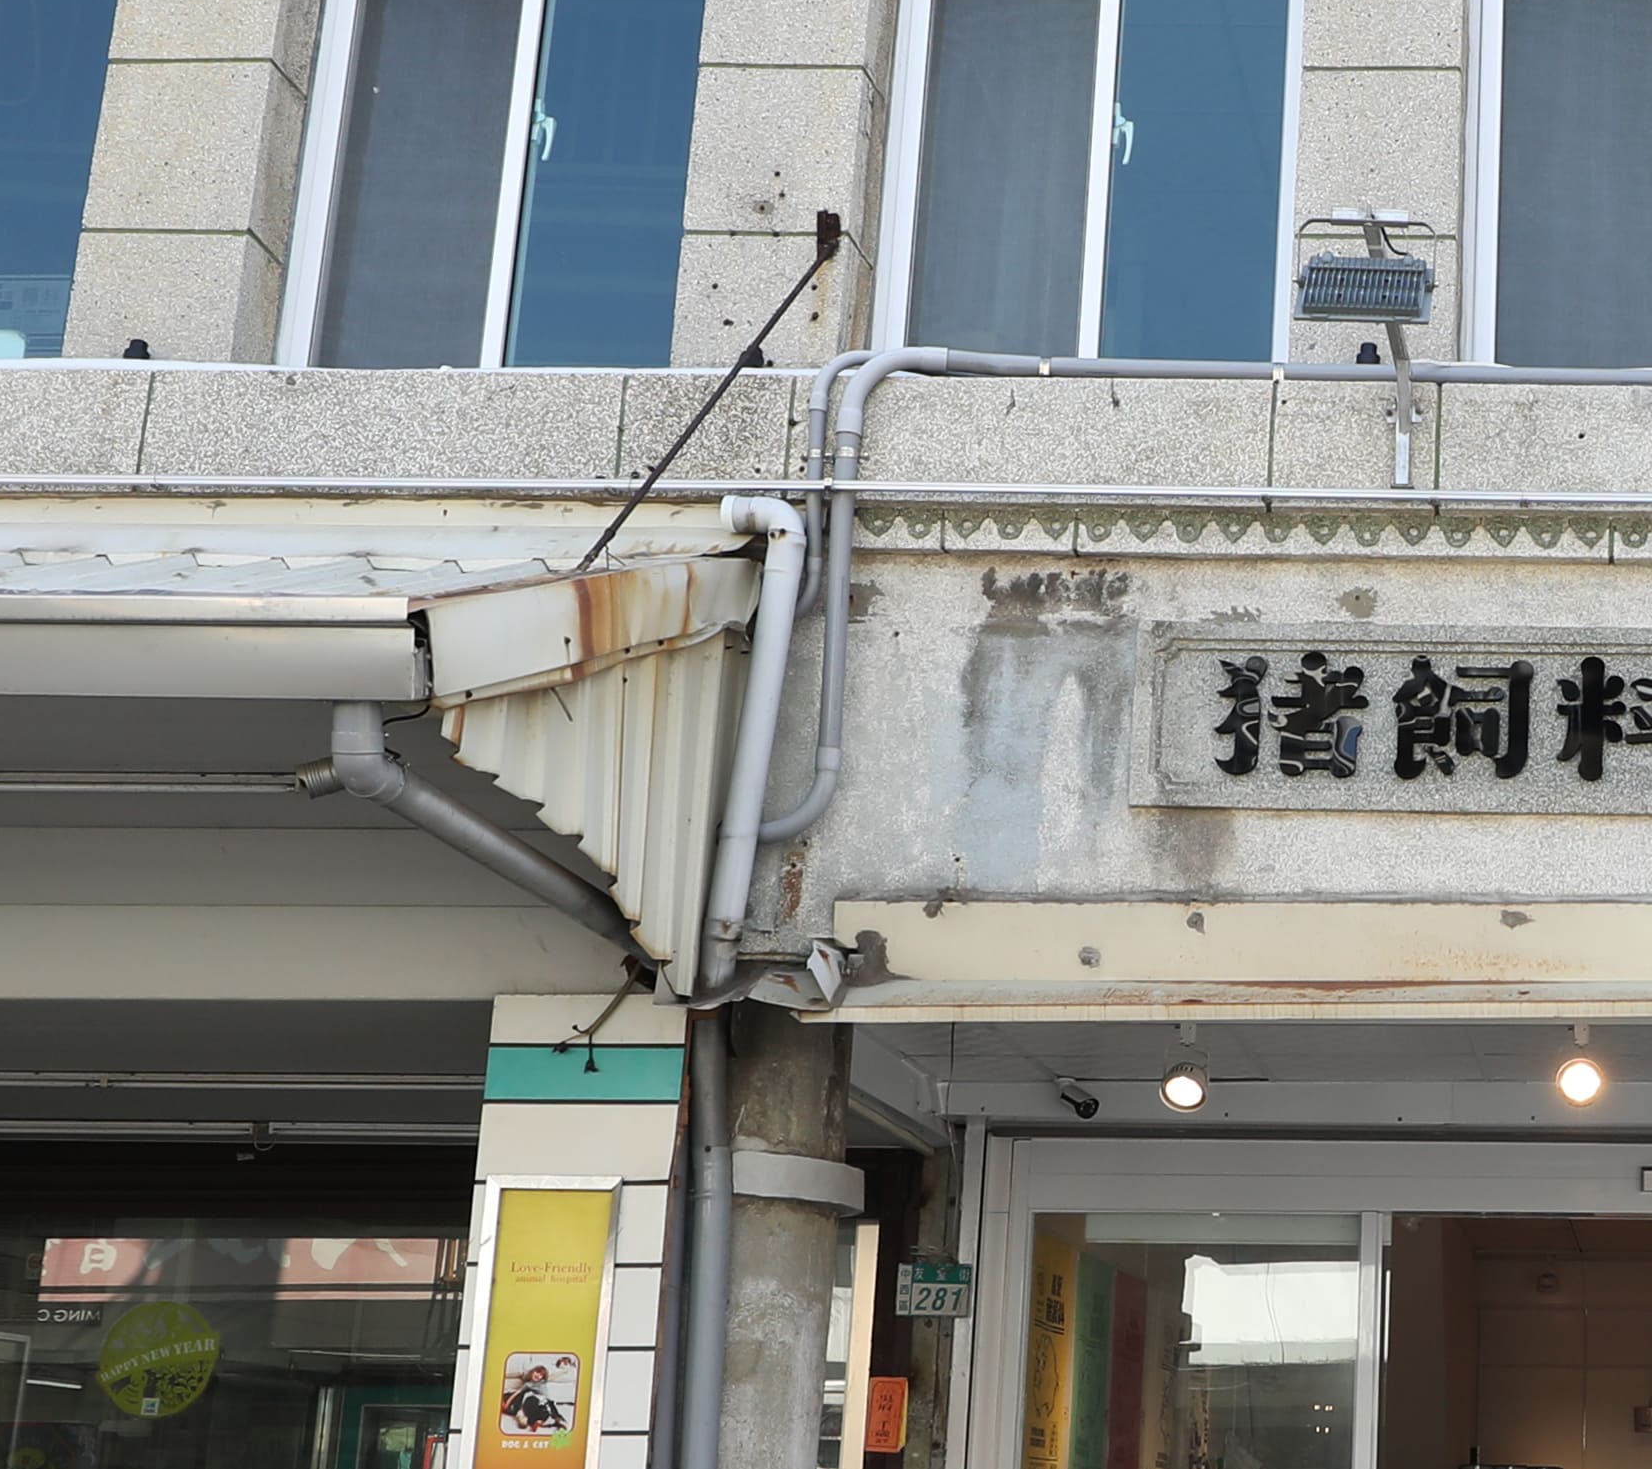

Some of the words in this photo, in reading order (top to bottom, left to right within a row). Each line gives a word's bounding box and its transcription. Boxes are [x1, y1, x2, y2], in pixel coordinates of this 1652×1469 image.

[511, 1260, 592, 1275] Love-Friendly
[914, 1287, 963, 1311] 281
[99, 1354, 141, 1383] HAPPY
[139, 1346, 174, 1367] NEW
[172, 1335, 217, 1358] YEAR
